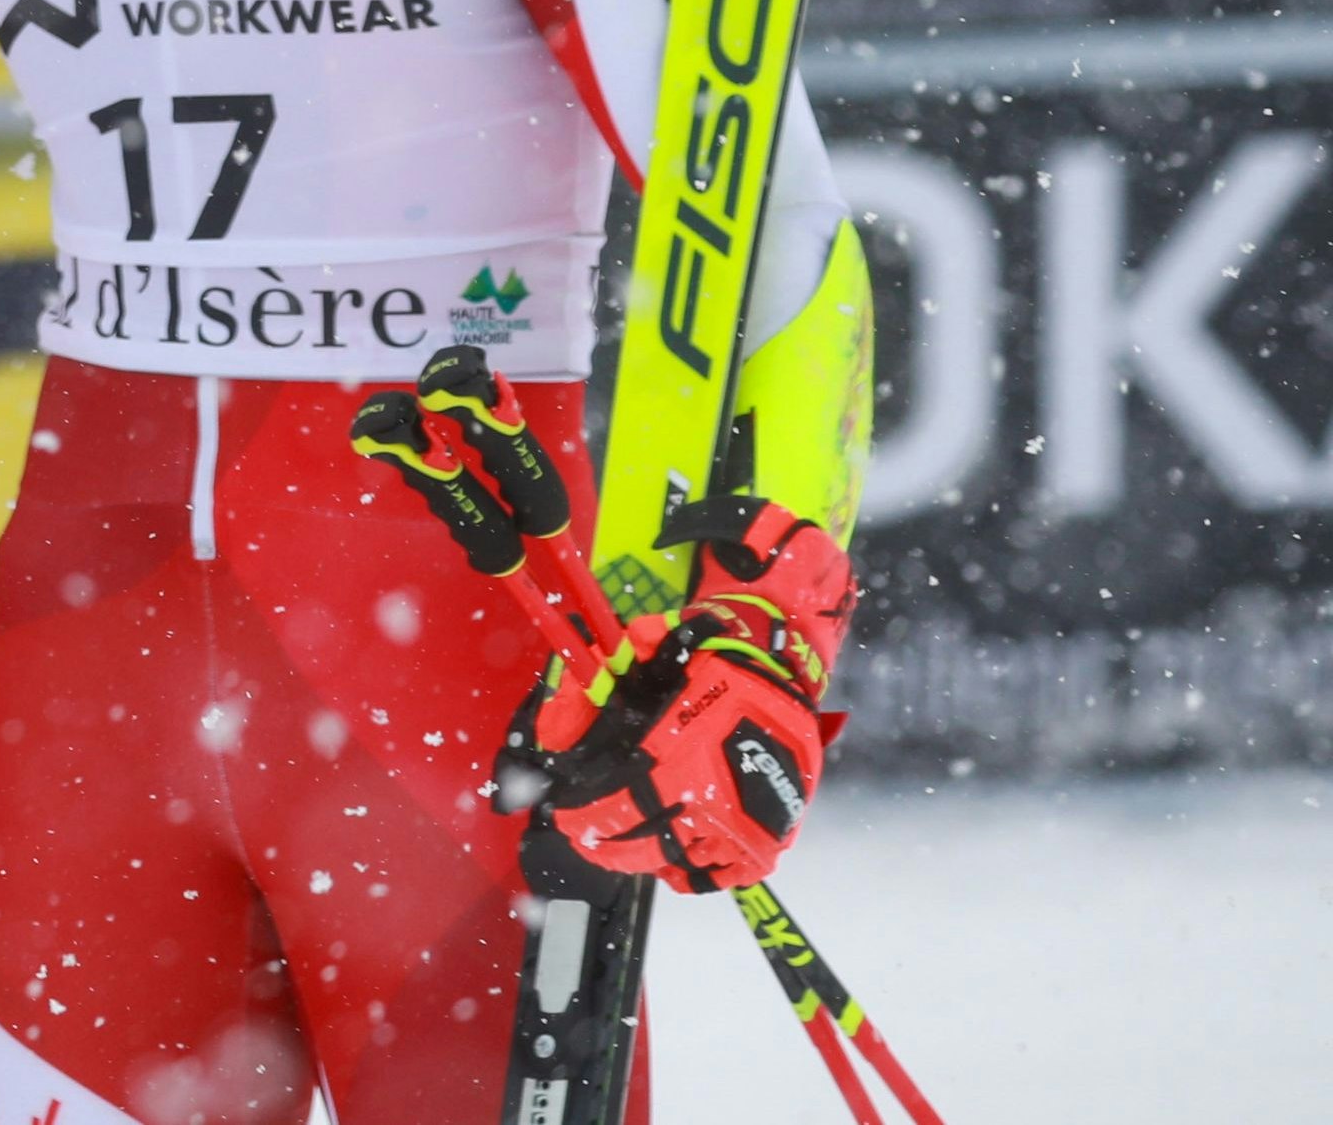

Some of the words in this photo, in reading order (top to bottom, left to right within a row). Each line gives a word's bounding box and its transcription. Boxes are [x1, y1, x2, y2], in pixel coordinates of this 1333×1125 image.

[89, 94, 276, 241] 17
[95, 264, 428, 349] d'Isère
[512, 437, 544, 481] LEKI
